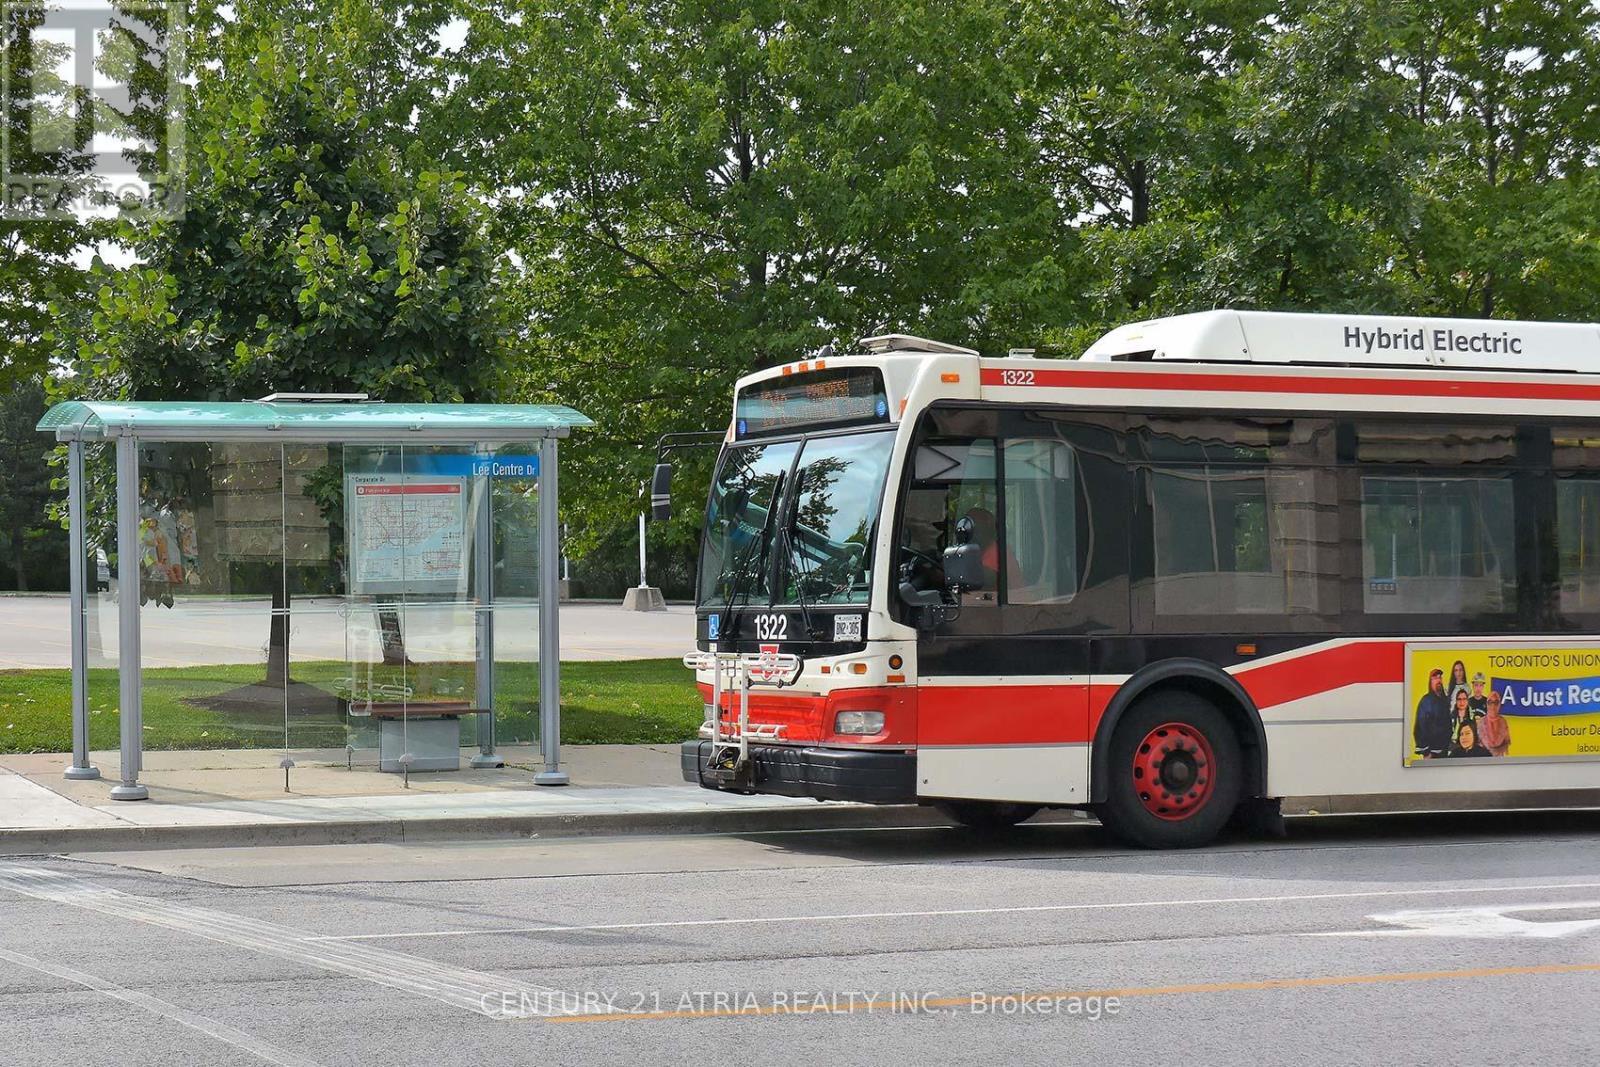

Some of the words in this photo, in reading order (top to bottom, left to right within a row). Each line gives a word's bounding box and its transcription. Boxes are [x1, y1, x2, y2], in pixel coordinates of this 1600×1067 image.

[1343, 326, 1424, 354] Hybrid
[1433, 329, 1522, 354] Electric
[1000, 370, 1035, 385] 1322
[472, 462, 490, 476] Lee
[492, 462, 524, 476] Centre
[526, 464, 536, 475] Dr
[753, 614, 788, 640] 1322
[1488, 655, 1560, 668] TORONTO'S
[1501, 685, 1516, 706] A
[1520, 685, 1563, 707] Just
[1551, 724, 1587, 737] Labour
